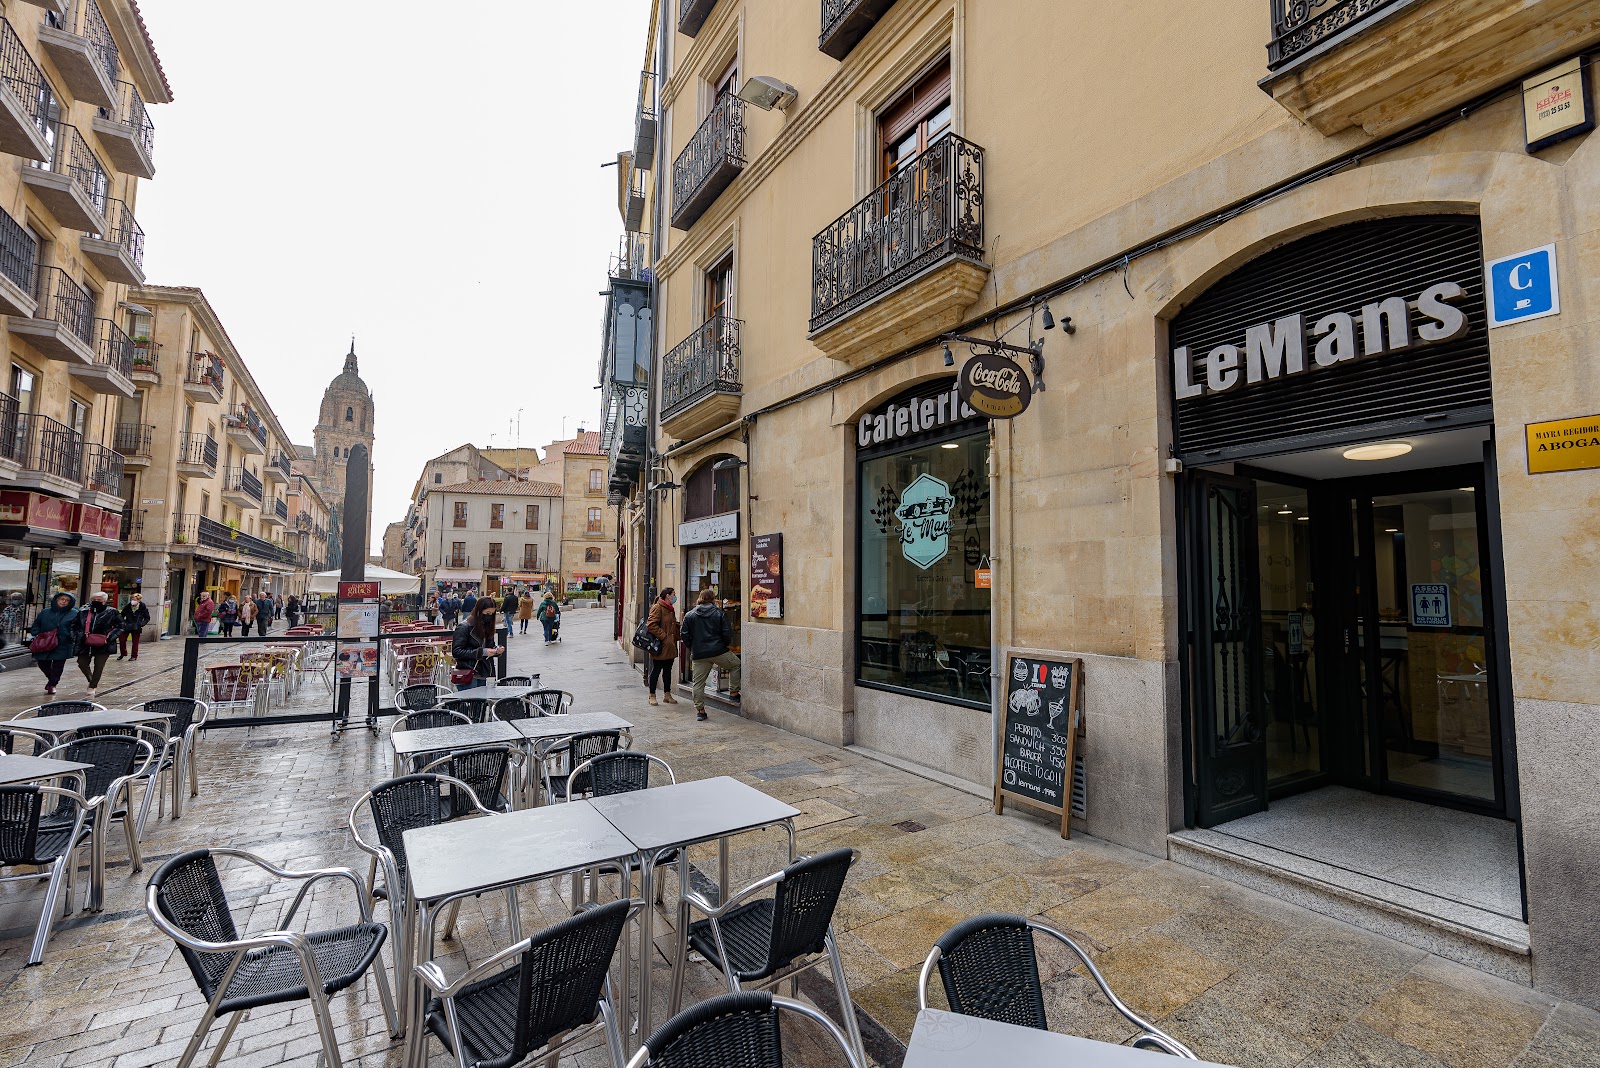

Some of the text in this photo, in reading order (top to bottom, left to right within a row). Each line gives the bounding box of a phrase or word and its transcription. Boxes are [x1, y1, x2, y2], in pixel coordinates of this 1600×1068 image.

[1508, 261, 1532, 291] C
[1535, 425, 1599, 440] MAYRA REGIDOR
[1014, 722, 1042, 739] PERRITO
[1009, 733, 1046, 752] SANDWICH
